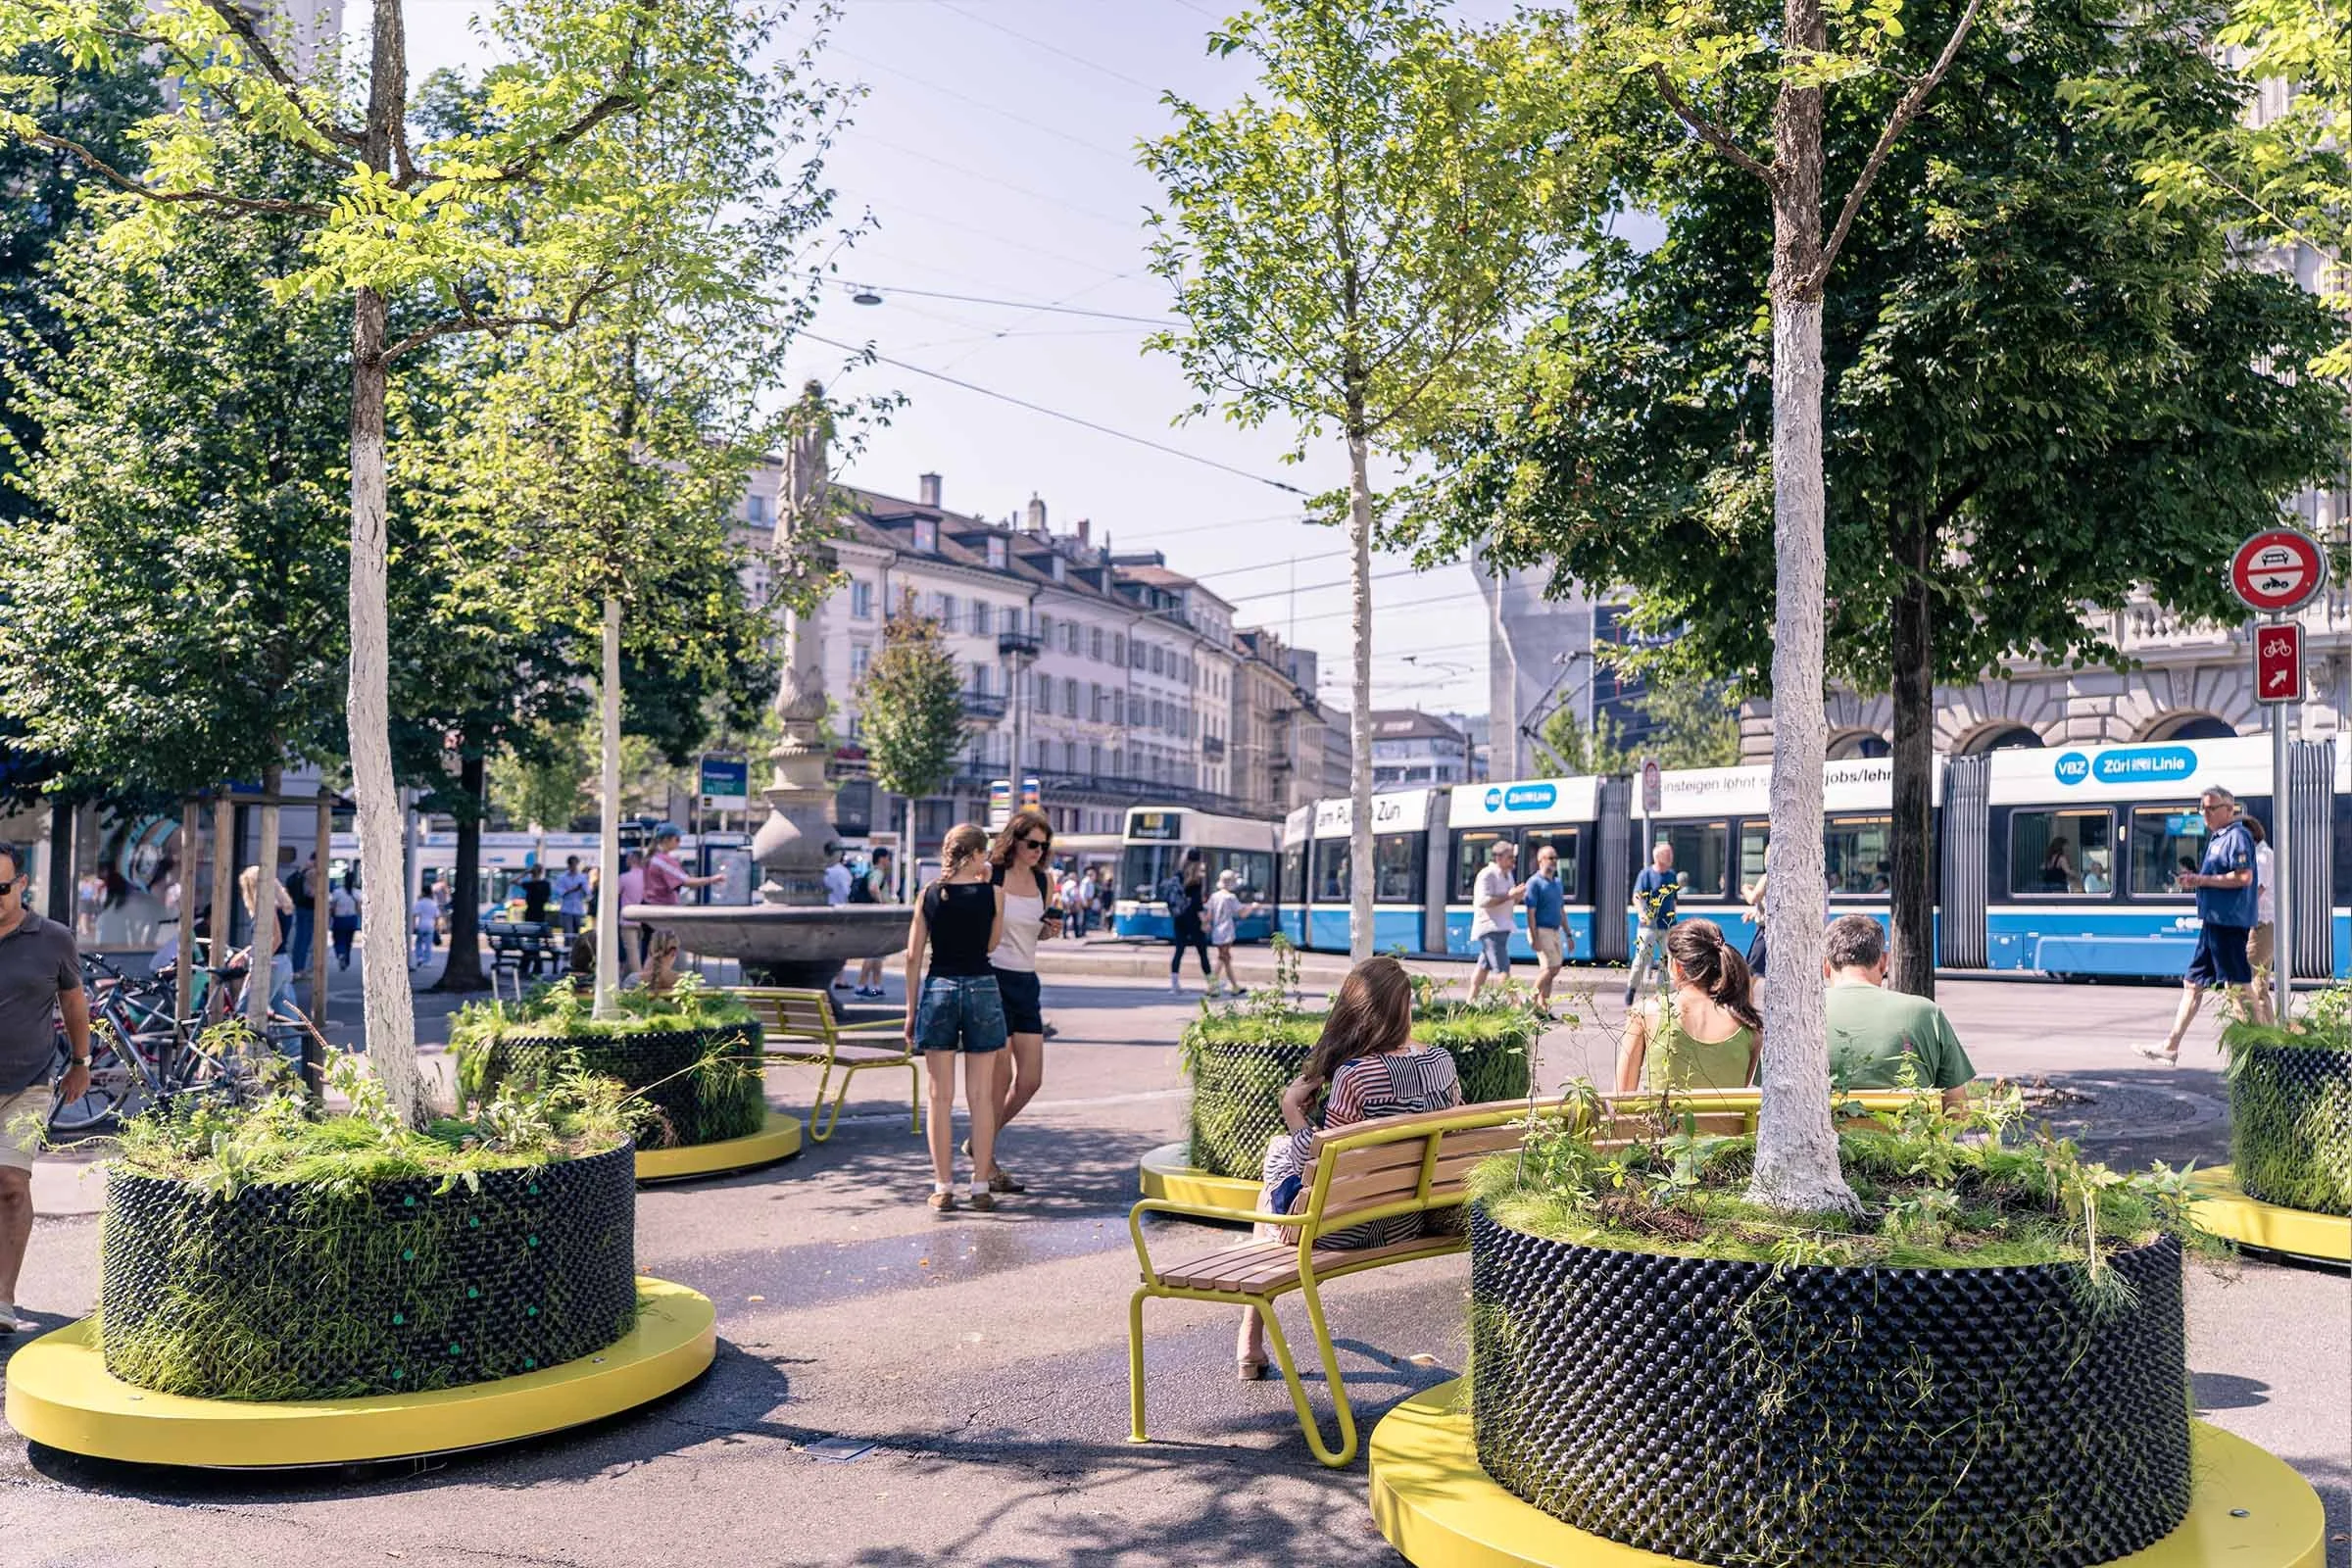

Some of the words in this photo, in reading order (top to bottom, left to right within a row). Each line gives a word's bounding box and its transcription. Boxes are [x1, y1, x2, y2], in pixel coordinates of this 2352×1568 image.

[2058, 760, 2085, 775] VBZ
[2152, 756, 2185, 771] Linie
[1664, 778, 1719, 795] insteigen
